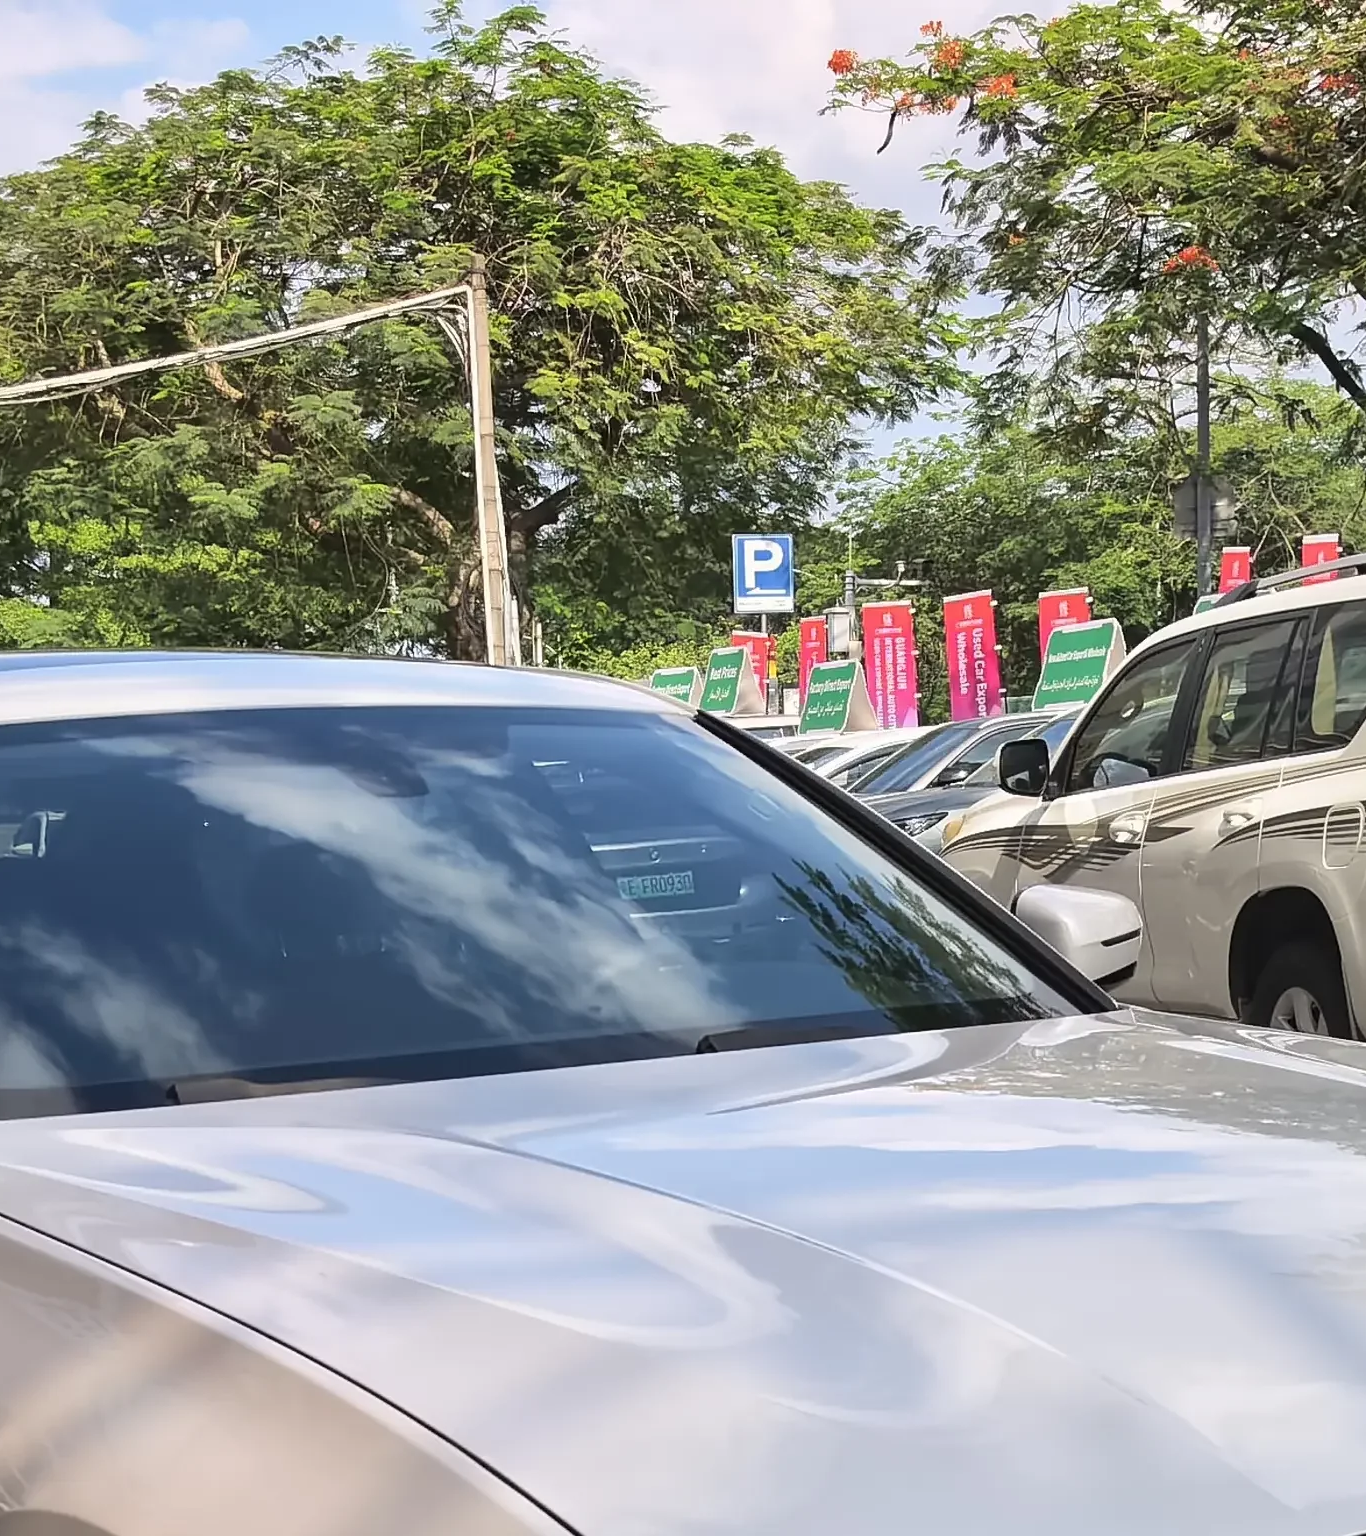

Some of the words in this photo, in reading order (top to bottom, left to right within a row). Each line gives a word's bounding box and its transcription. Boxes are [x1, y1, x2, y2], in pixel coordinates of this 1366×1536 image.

[744, 540, 783, 588] P
[972, 628, 985, 659] Used
[956, 632, 970, 695] Wholesale
[974, 660, 985, 683] Car
[976, 684, 988, 718] Expor
